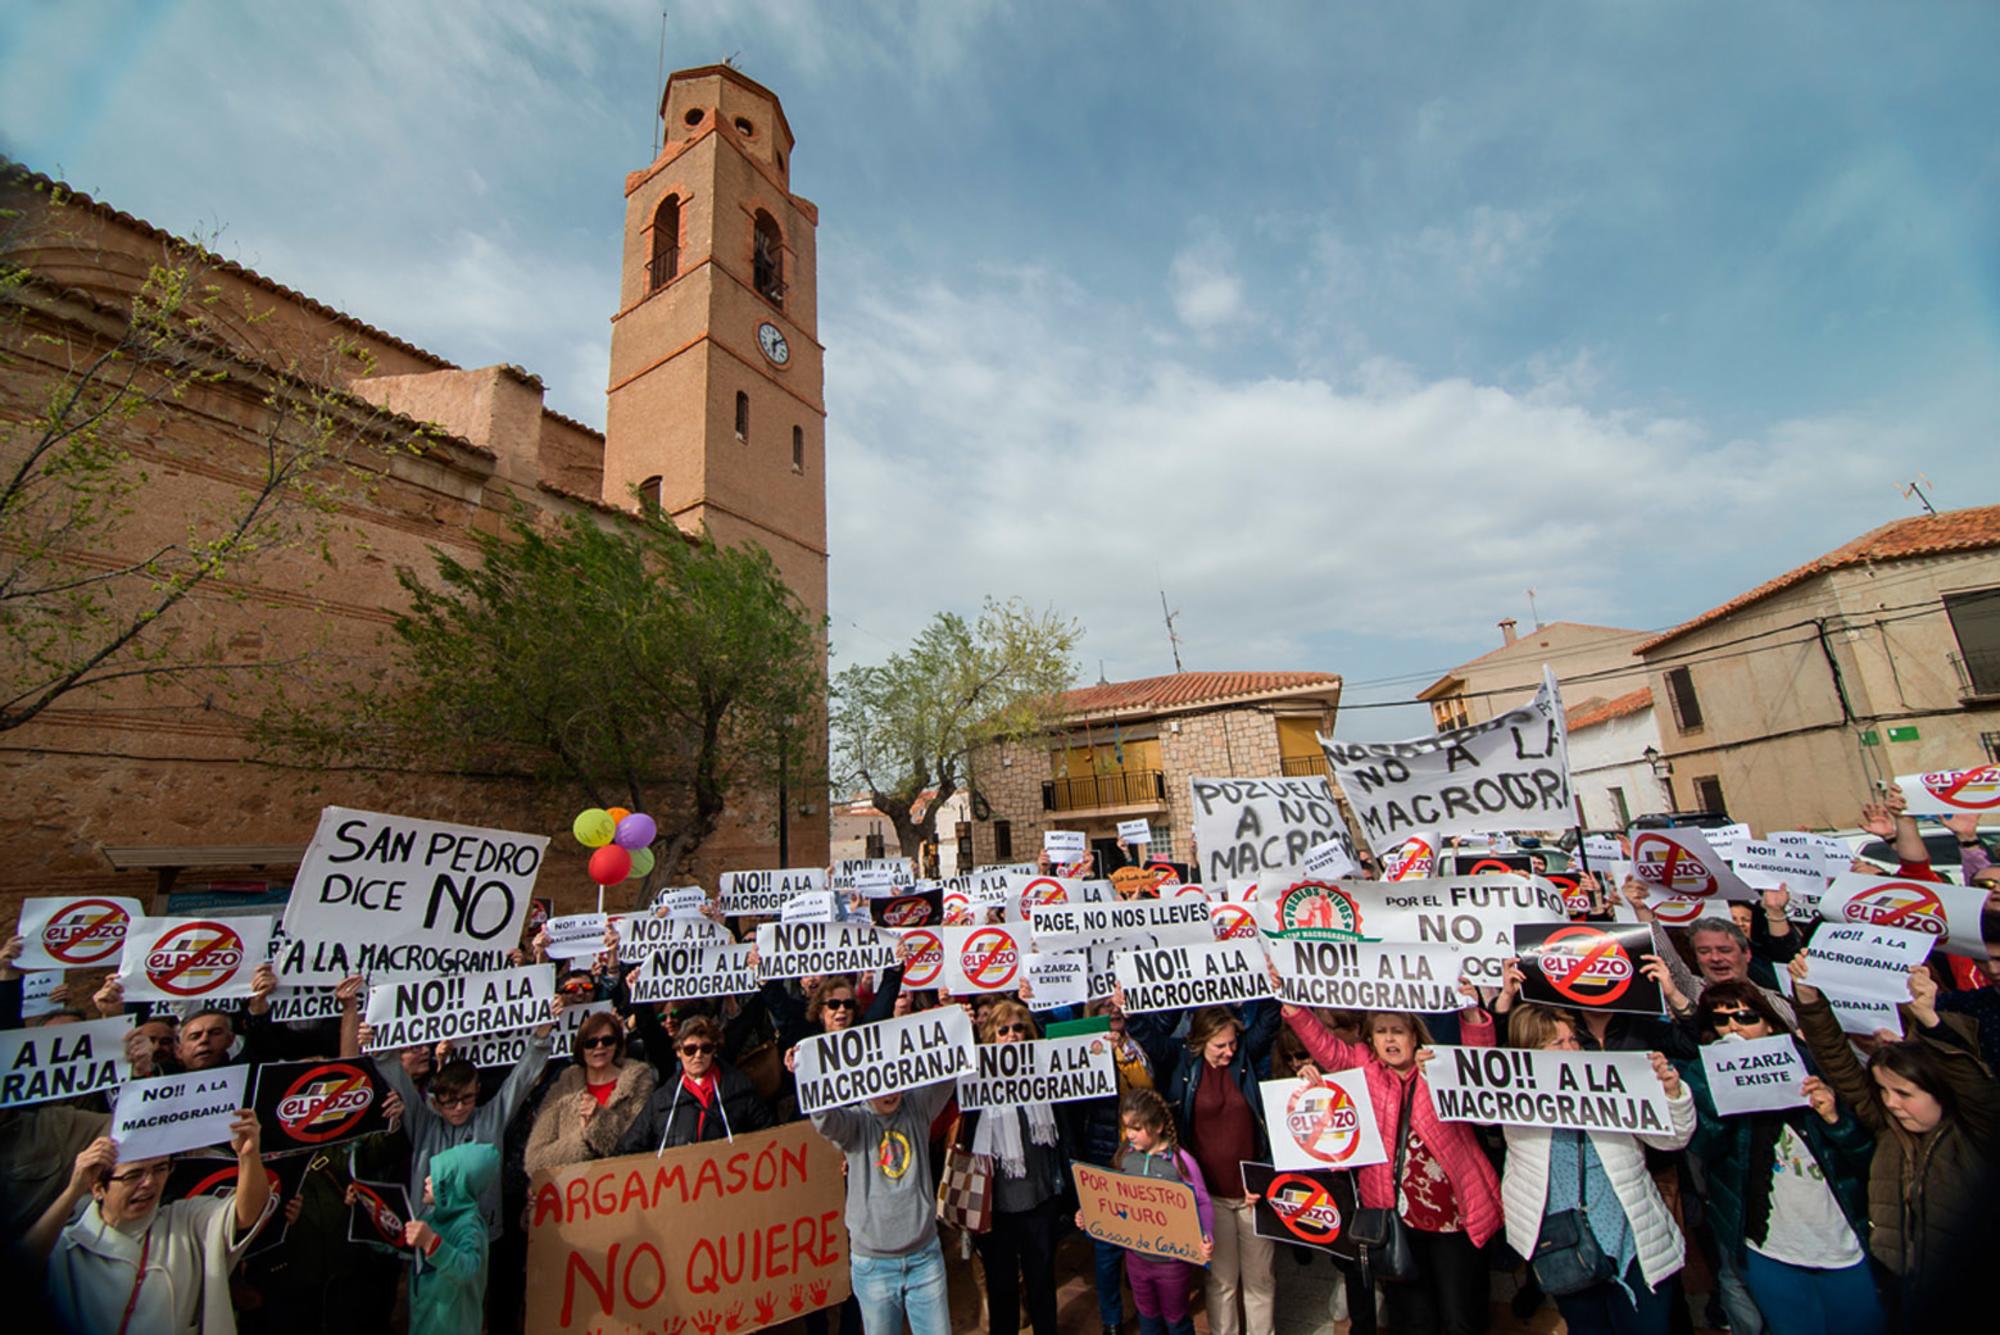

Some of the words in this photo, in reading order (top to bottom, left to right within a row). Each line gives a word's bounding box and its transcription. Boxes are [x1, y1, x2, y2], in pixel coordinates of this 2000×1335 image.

[1353, 759, 1410, 794] NO
[1448, 744, 1480, 773] A
[1236, 806, 1261, 840] A
[1279, 800, 1334, 828] NO
[328, 820, 417, 864] SAN
[425, 832, 539, 877] PEDRO
[1746, 846, 1776, 857] NO!!
[1780, 837, 1807, 845] NO!!
[733, 873, 771, 894] NO!!
[781, 877, 792, 891] A
[795, 875, 812, 889] LA
[1739, 862, 1821, 878] MACROGRANJA
[319, 873, 407, 912] DICE
[423, 874, 515, 941] NO
[1386, 896, 1418, 908] POR
[1426, 895, 1442, 907] EL
[1451, 886, 1563, 916] FUTURO
[554, 921, 576, 931] NO!!
[631, 919, 674, 942] NO!!
[684, 924, 694, 940] A
[700, 923, 716, 939] LA
[1034, 911, 1079, 934] PAGE,
[1084, 911, 1107, 930] NO
[1112, 908, 1145, 929] NOS
[1150, 903, 1209, 925] LLEVES
[1418, 914, 1483, 945] NO
[1496, 931, 1510, 945] A
[774, 922, 826, 951] NO!!
[840, 928, 851, 947] A
[857, 926, 880, 946] LA
[1829, 930, 1864, 941] NO!!
[1872, 937, 1882, 946] A
[1886, 938, 1906, 949] LA
[282, 940, 305, 976] A
[312, 941, 348, 972] LA
[356, 943, 516, 978] MACROGRANJA
[653, 949, 703, 977] NO!!
[716, 954, 728, 973] A
[1030, 965, 1041, 975] LA
[1044, 962, 1081, 973] ZARZA
[1135, 948, 1192, 983] NO!!
[1206, 954, 1219, 976] A
[1224, 950, 1249, 974] LA
[1293, 943, 1360, 977] NO!!
[1378, 954, 1395, 979] A
[1402, 954, 1434, 981] LA
[1808, 948, 1910, 974] MACROGRANJA
[1039, 974, 1073, 984] EXISTE
[1124, 973, 1271, 1011] MACROGRANJA
[395, 977, 465, 1018] NO!!
[481, 982, 498, 1005] A
[505, 977, 533, 1001] LA
[12, 1040, 37, 1070] A
[50, 1033, 93, 1065] LA
[816, 1025, 883, 1074] NO!!
[900, 1028, 915, 1056] A
[919, 1020, 949, 1050] LA
[979, 1044, 1036, 1079] NO!!
[1050, 1050, 1063, 1074] A
[1067, 1047, 1090, 1071] LA
[1716, 1060, 1735, 1073] LA
[1738, 1050, 1796, 1072] ZARZA
[1454, 1048, 1536, 1090] NO!!
[1559, 1063, 1579, 1092] A
[1586, 1063, 1627, 1094] LA
[1735, 1070, 1792, 1088] EXISTE
[142, 1083, 185, 1103] NO!!
[197, 1082, 207, 1093] A
[211, 1079, 228, 1092] LA
[122, 1102, 236, 1131] MACROGRANJA
[533, 1140, 808, 1228] ARGAMASÓN
[1080, 1170, 1109, 1192] POR
[1116, 1181, 1187, 1210] NUESTRO
[1098, 1198, 1168, 1227] FUTURO
[560, 1242, 666, 1328] NO
[687, 1210, 839, 1296] QUIERE
